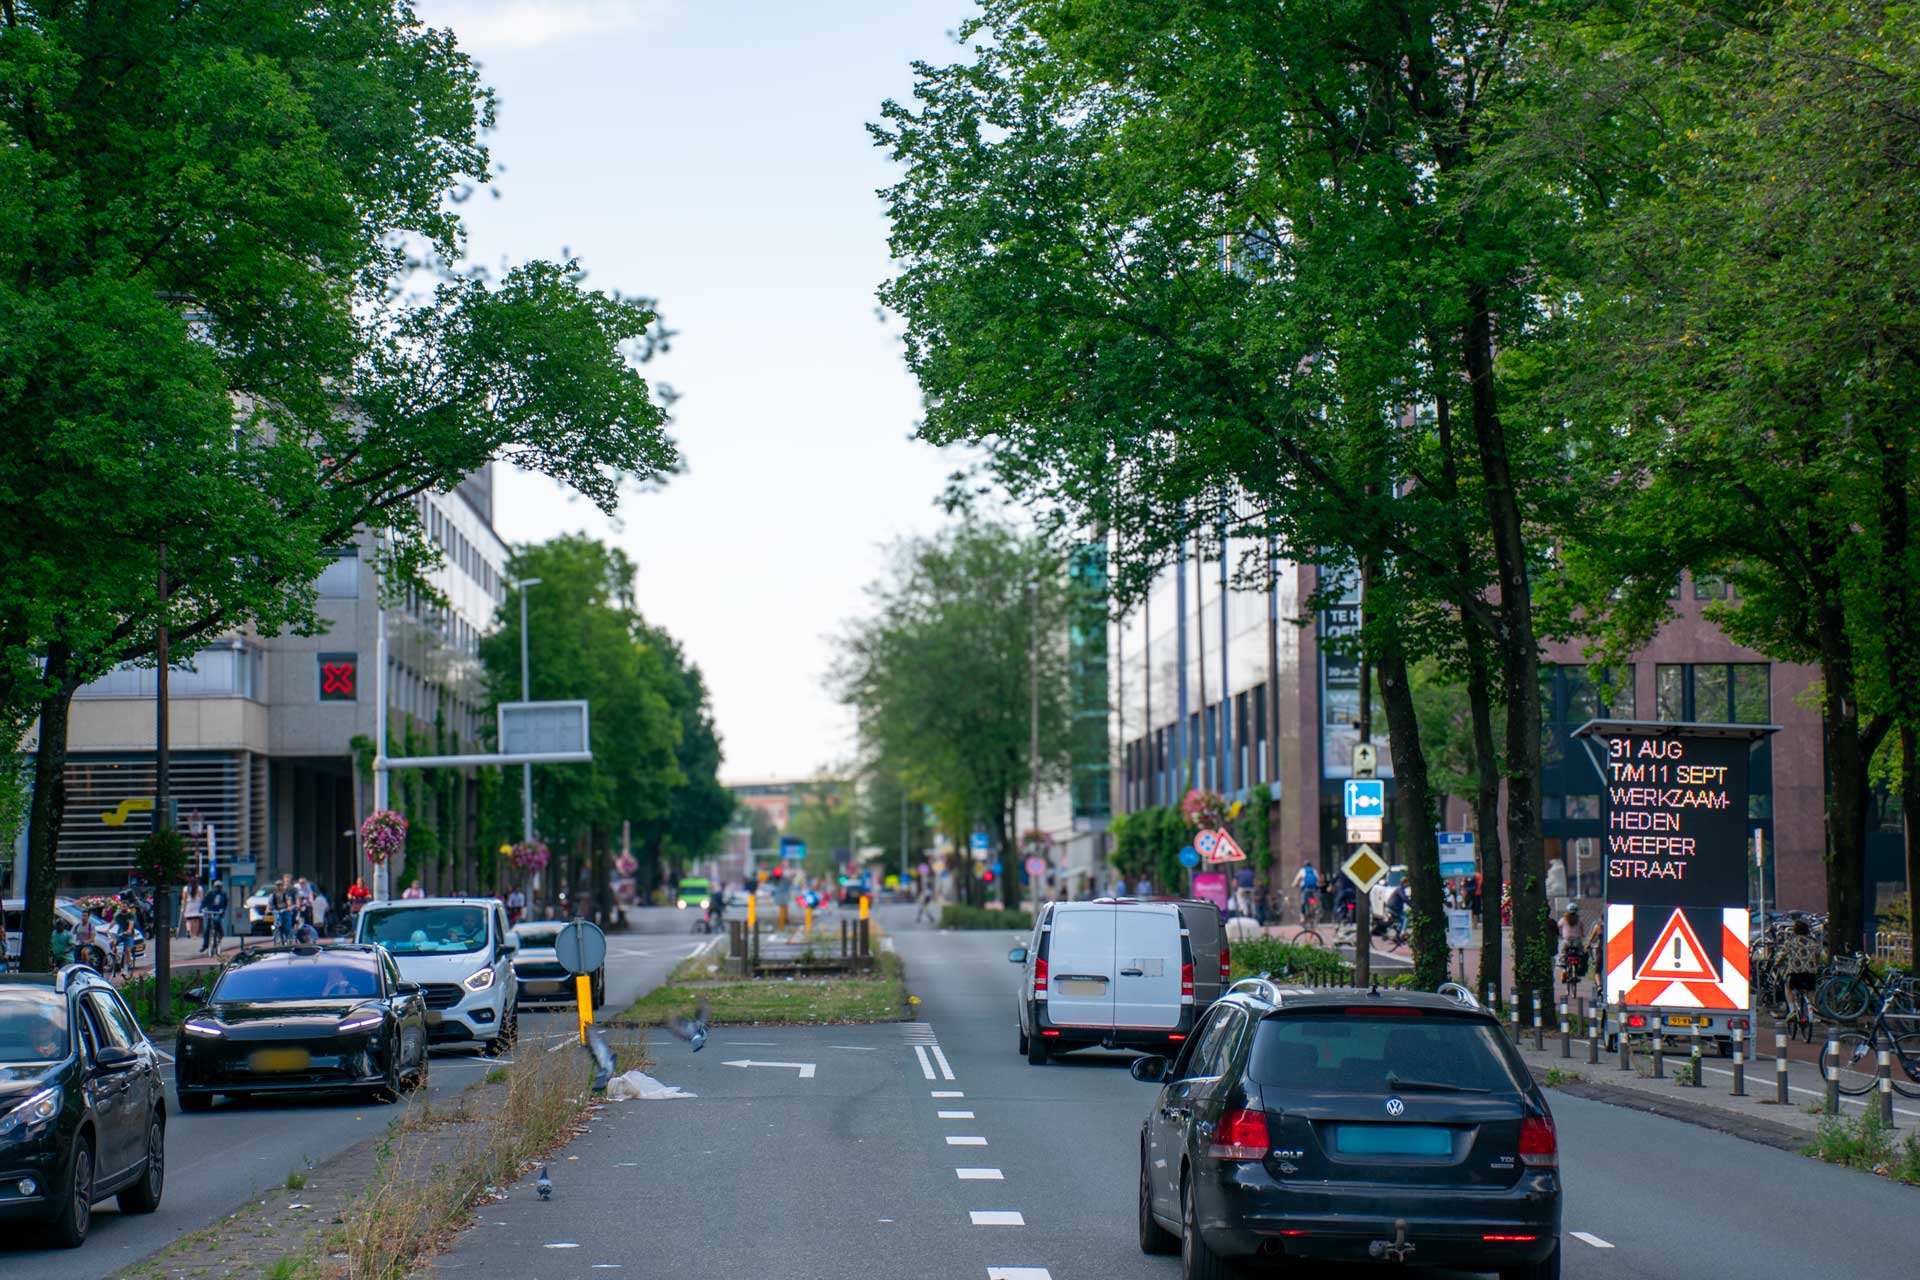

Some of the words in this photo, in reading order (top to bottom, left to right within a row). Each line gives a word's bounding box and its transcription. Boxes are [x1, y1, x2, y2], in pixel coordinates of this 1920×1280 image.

[1610, 739, 1631, 758] 31
[1638, 740, 1683, 759] AUG
[1610, 763, 1645, 782] T/M
[1649, 765, 1669, 783] 11
[1677, 766, 1728, 784] SEPT
[1610, 787, 1731, 809] WERKZAAM-
[1610, 811, 1680, 831] HEDEN
[1609, 835, 1696, 855] WEEPER
[1610, 860, 1687, 880] STRAAT
[1273, 1150, 1303, 1159] GOLF
